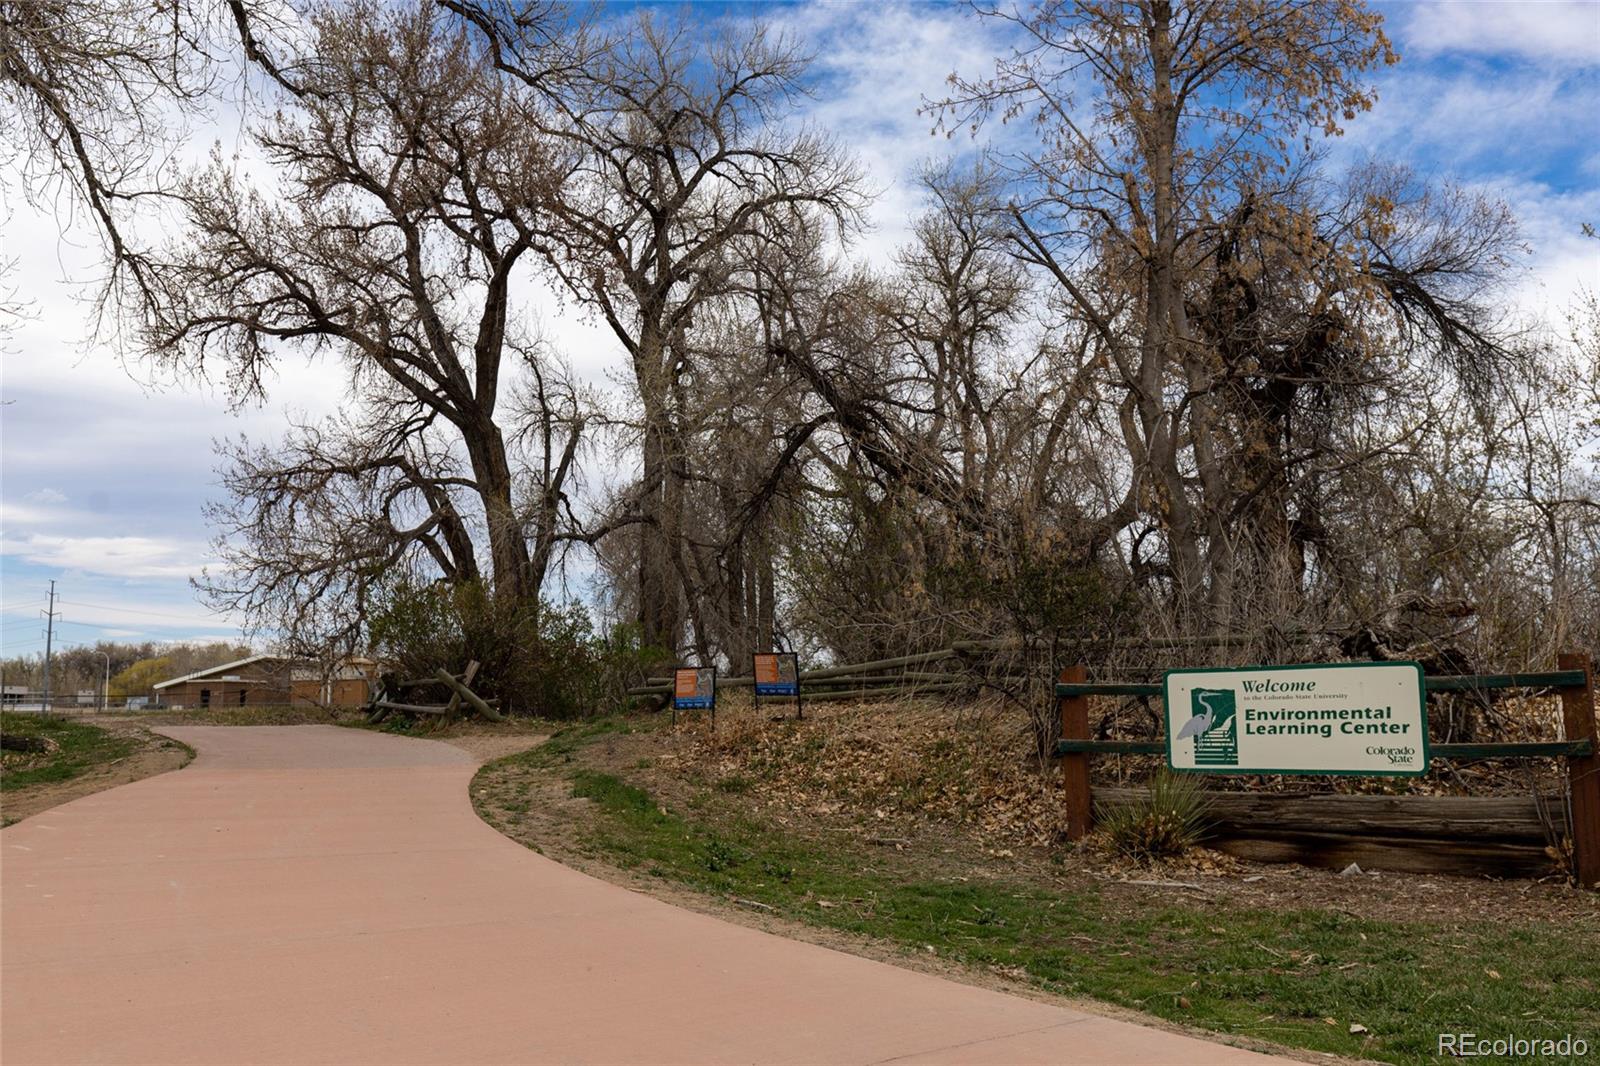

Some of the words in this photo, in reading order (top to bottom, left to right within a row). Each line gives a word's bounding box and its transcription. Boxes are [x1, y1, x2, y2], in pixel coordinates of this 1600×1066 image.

[1242, 679, 1316, 693] Welcome
[1245, 706, 1392, 721] Environmental
[1246, 722, 1332, 737] Learning
[1340, 721, 1410, 734] Center
[1366, 746, 1415, 756] Colorado
[1388, 754, 1413, 764] State
